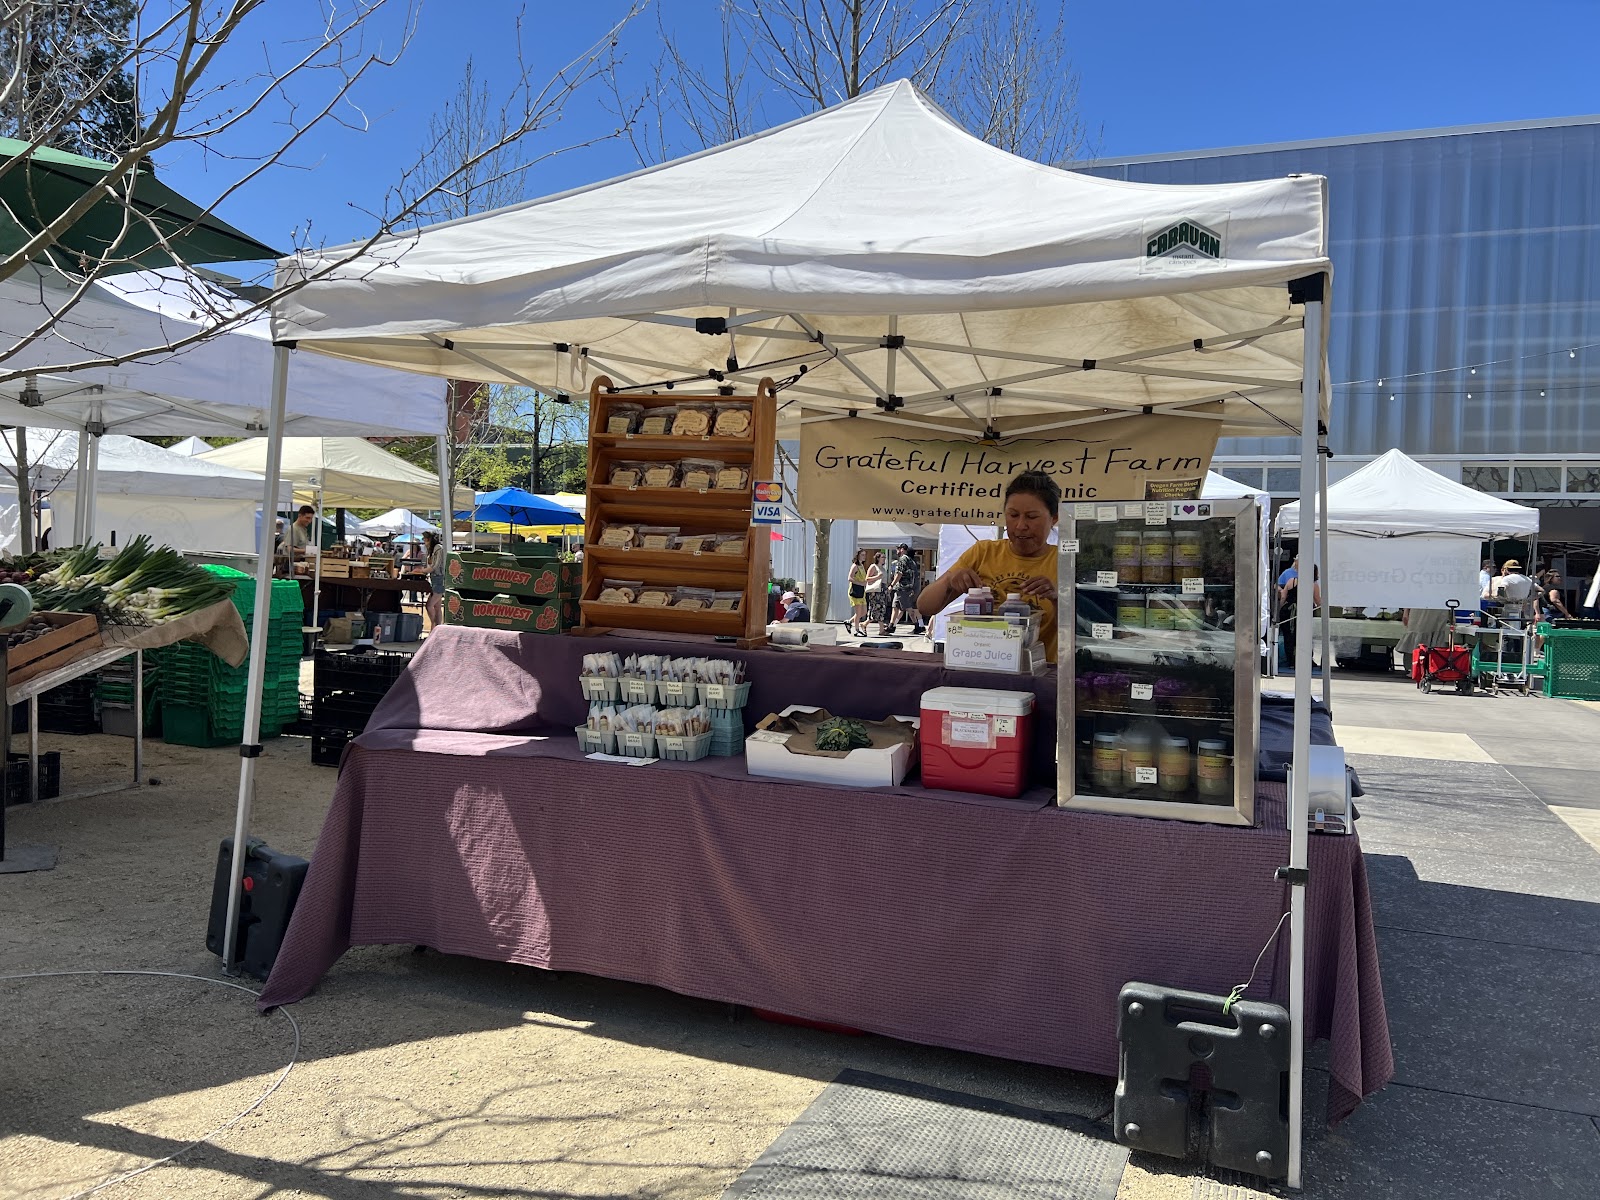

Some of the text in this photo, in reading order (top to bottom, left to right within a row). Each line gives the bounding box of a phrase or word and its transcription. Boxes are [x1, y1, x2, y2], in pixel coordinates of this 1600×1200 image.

[1147, 221, 1220, 258] CARAVAN
[815, 445, 1201, 475] Grateful Harvest Farm
[900, 479, 1002, 498] Certified
[757, 506, 781, 517] VISA
[872, 507, 1003, 519] www.gratefulhar
[472, 567, 532, 585] NORTHWEST
[472, 603, 533, 621] NORTHWEST
[952, 647, 1012, 661] Grape Juice
